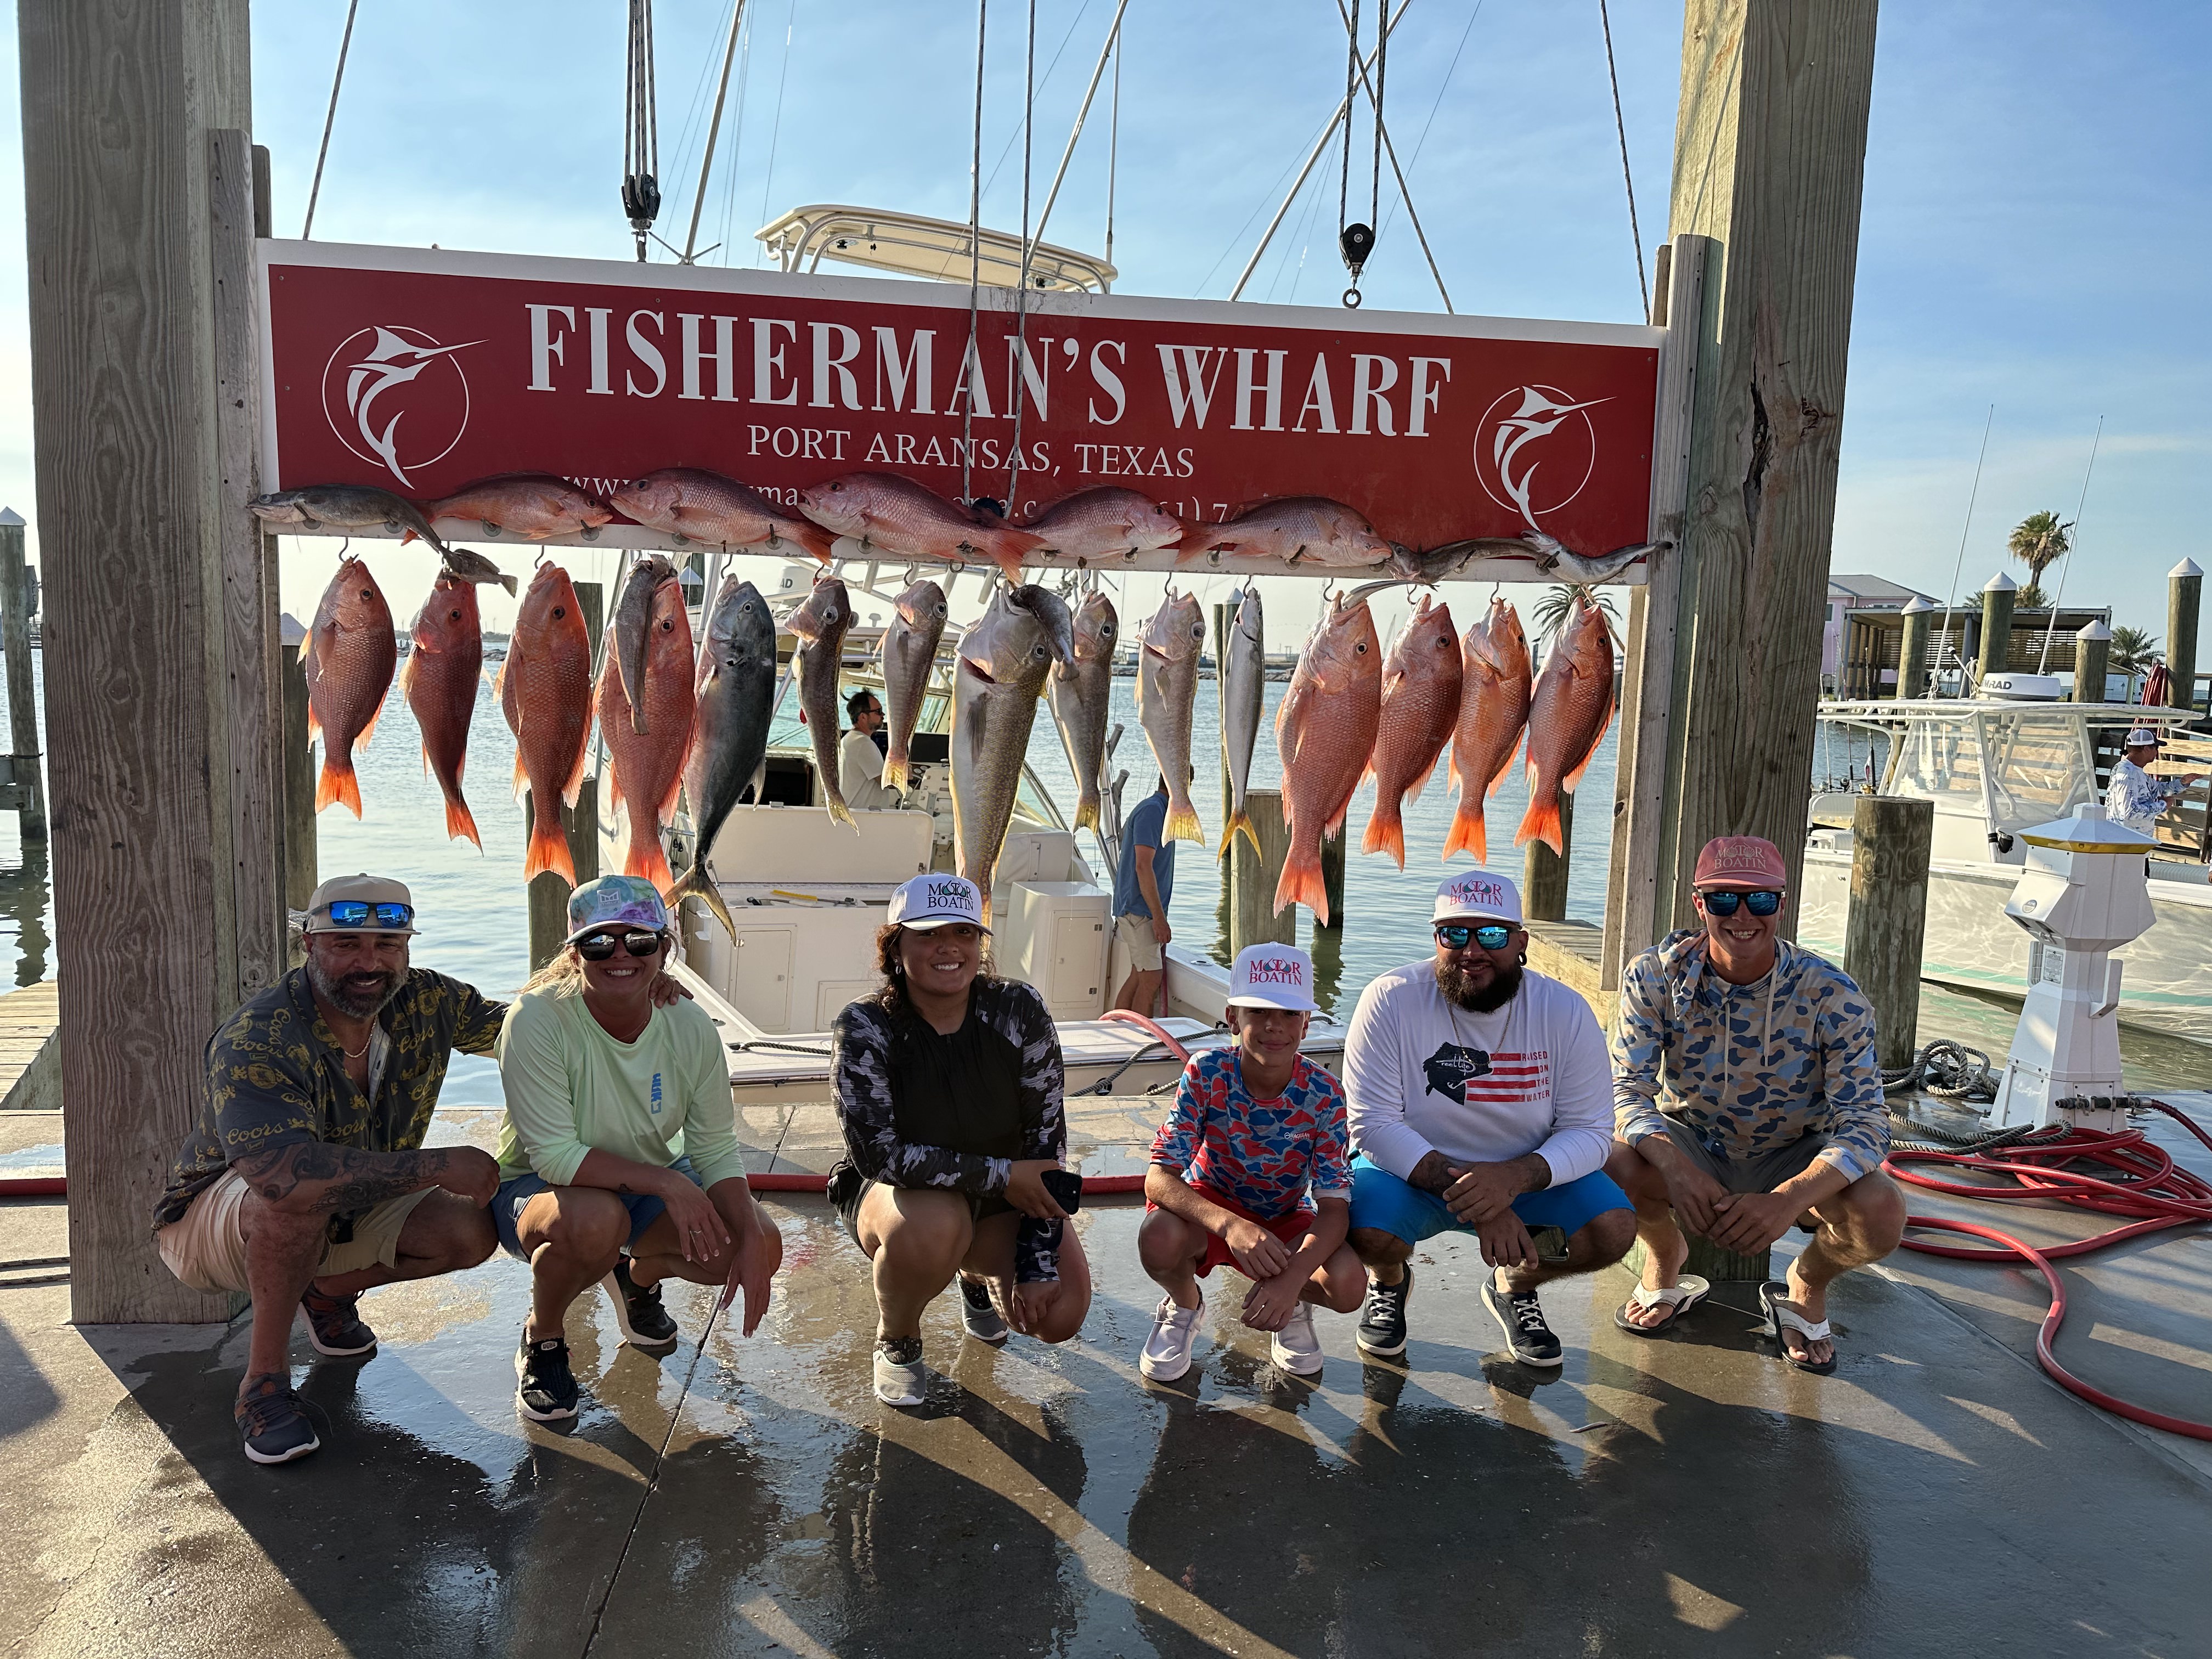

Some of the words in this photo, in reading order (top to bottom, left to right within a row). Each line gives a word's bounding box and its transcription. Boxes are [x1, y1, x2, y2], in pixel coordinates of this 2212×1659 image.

[525, 303, 1126, 425] FISHERMAN'S
[1155, 344, 1451, 437] WHARF
[747, 425, 850, 460] PORT
[864, 432, 1060, 477] ARANSAS,
[1074, 444, 1194, 478] TEXAS
[1714, 857, 1767, 869] BOATIN
[927, 896, 973, 911] BOATIN
[1449, 893, 1503, 907] BOATIN
[1249, 972, 1302, 986] BOATIN
[1522, 1051, 1548, 1062] RAISED
[1539, 1064, 1549, 1073] ON
[1537, 1077, 1549, 1087] THE
[1526, 1090, 1550, 1102] WATER
[225, 1122, 285, 1146] Coors
